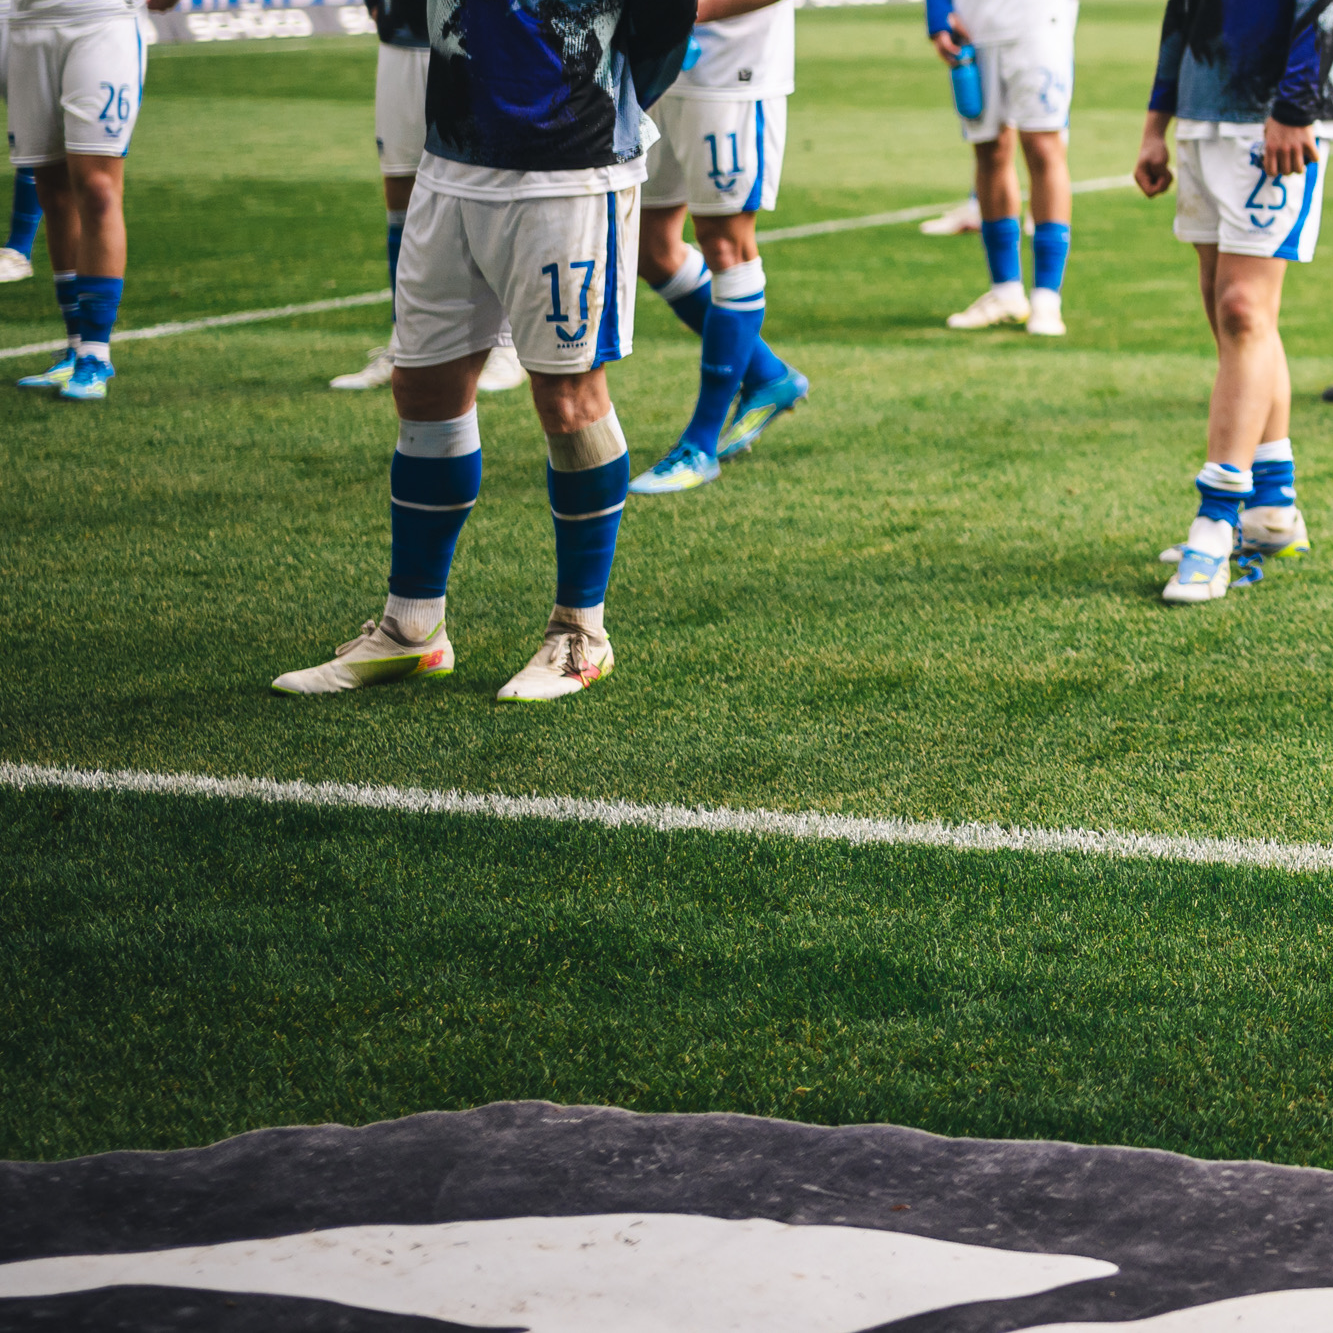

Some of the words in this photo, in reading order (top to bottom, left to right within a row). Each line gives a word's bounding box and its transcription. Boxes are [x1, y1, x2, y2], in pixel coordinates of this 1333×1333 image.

[98, 81, 130, 123] 26
[704, 132, 744, 178] 11
[541, 259, 595, 322] 17
